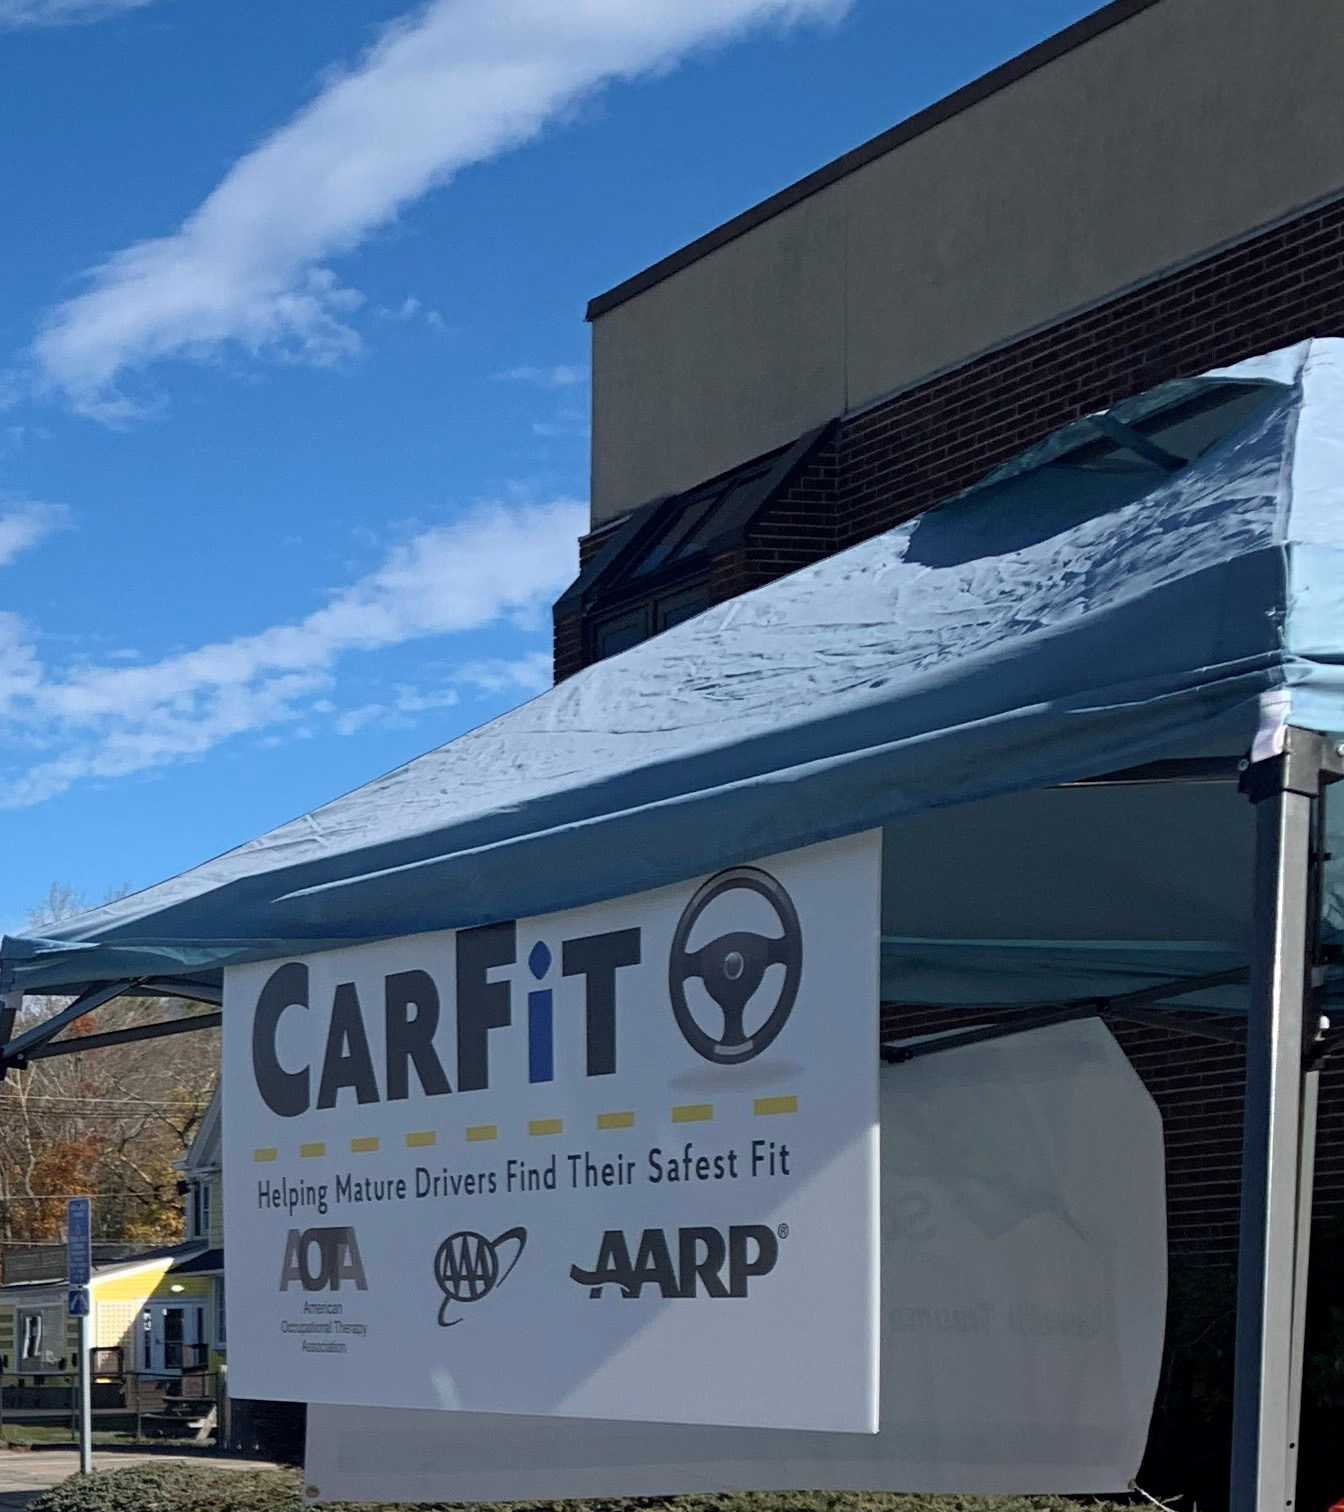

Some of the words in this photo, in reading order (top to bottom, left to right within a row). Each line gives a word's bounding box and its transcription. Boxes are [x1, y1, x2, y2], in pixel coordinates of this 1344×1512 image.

[258, 1177, 328, 1216] Helping
[335, 1173, 406, 1204] Mature
[415, 1167, 497, 1198] Drivers
[507, 1153, 557, 1192] Find
[567, 1151, 636, 1188] Their
[648, 1143, 738, 1183] Safest
[751, 1140, 791, 1177] Fit
[279, 1226, 368, 1292] AOTA
[438, 1232, 494, 1300] AAA
